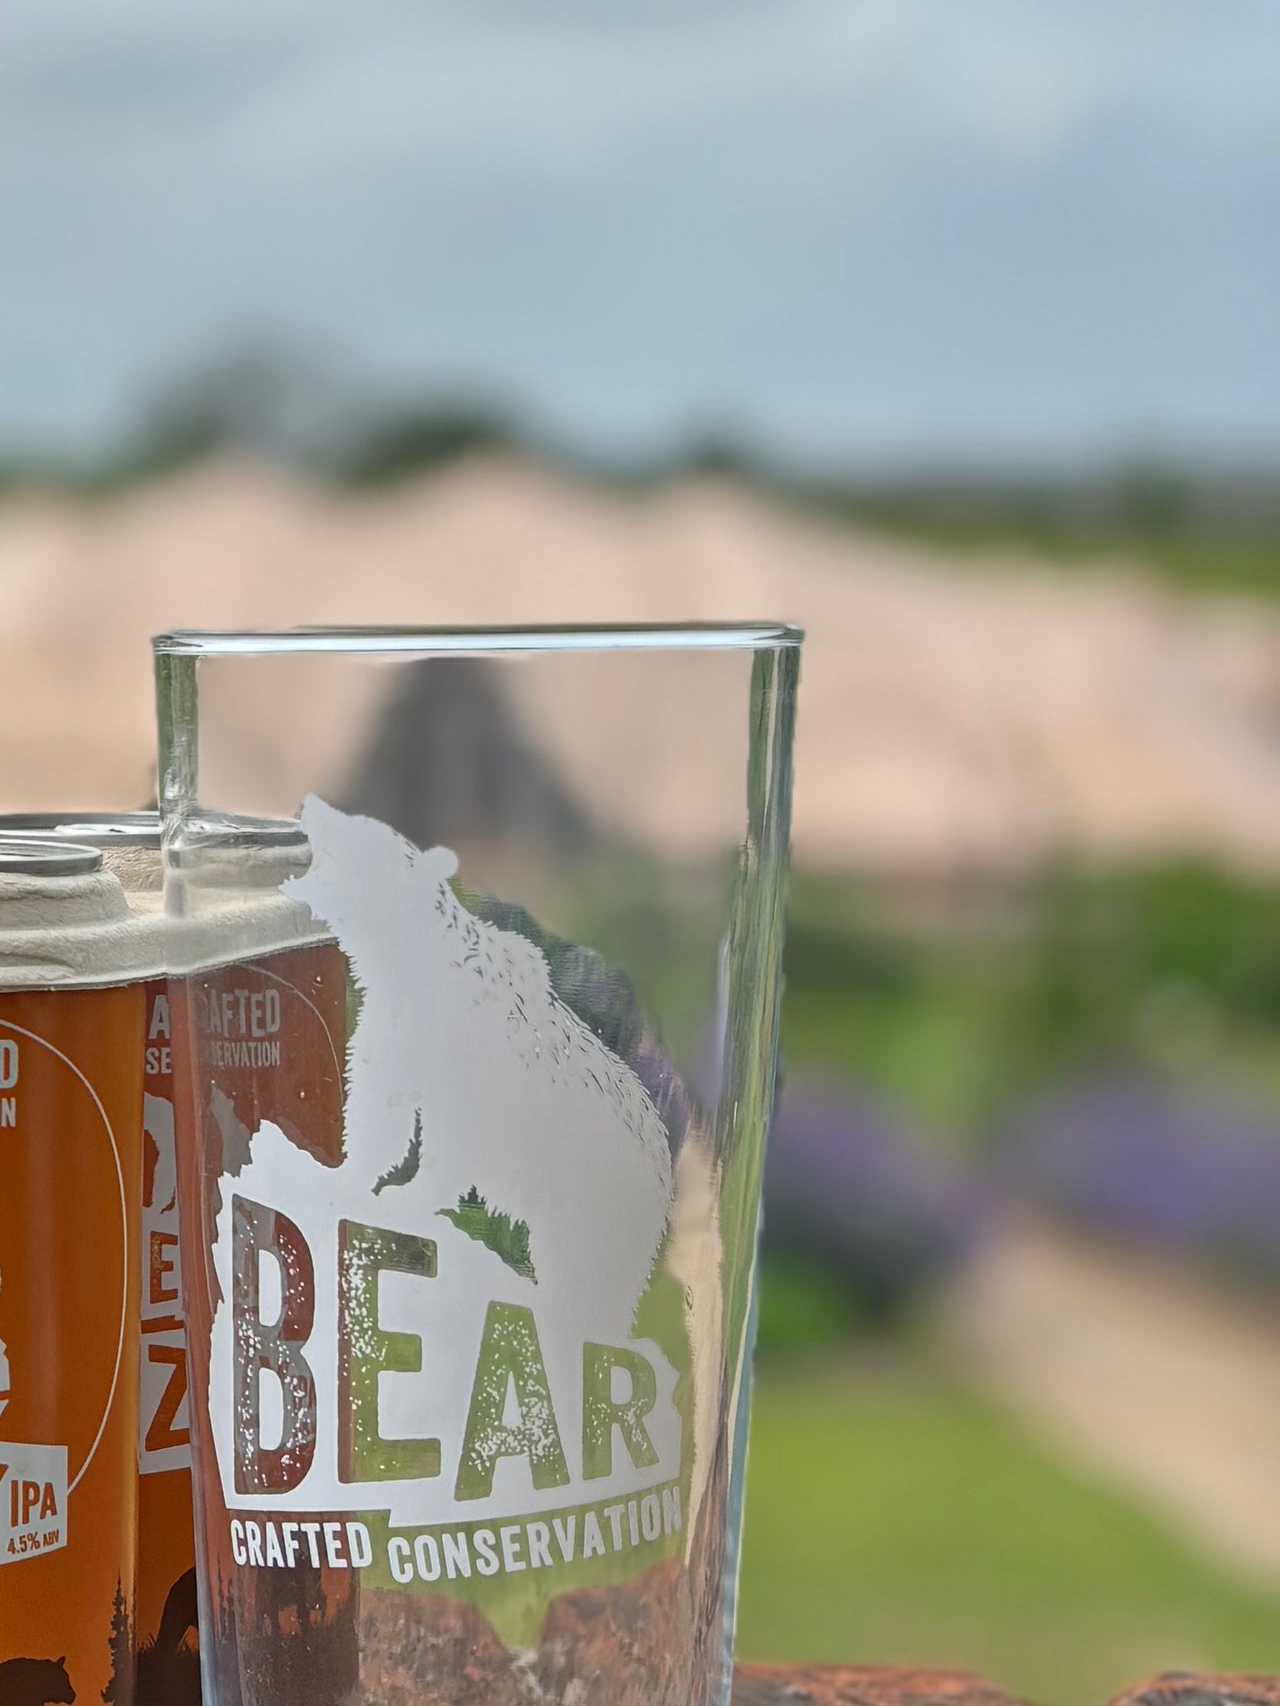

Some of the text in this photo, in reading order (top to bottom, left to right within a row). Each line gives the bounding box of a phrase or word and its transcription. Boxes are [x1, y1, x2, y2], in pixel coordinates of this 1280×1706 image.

[232, 1192, 660, 1502] BEAR
[10, 1479, 58, 1528] IPA
[230, 1486, 683, 1585] CRAFTED CONSERVATION
[7, 1529, 60, 1555] 4.5% ABV
